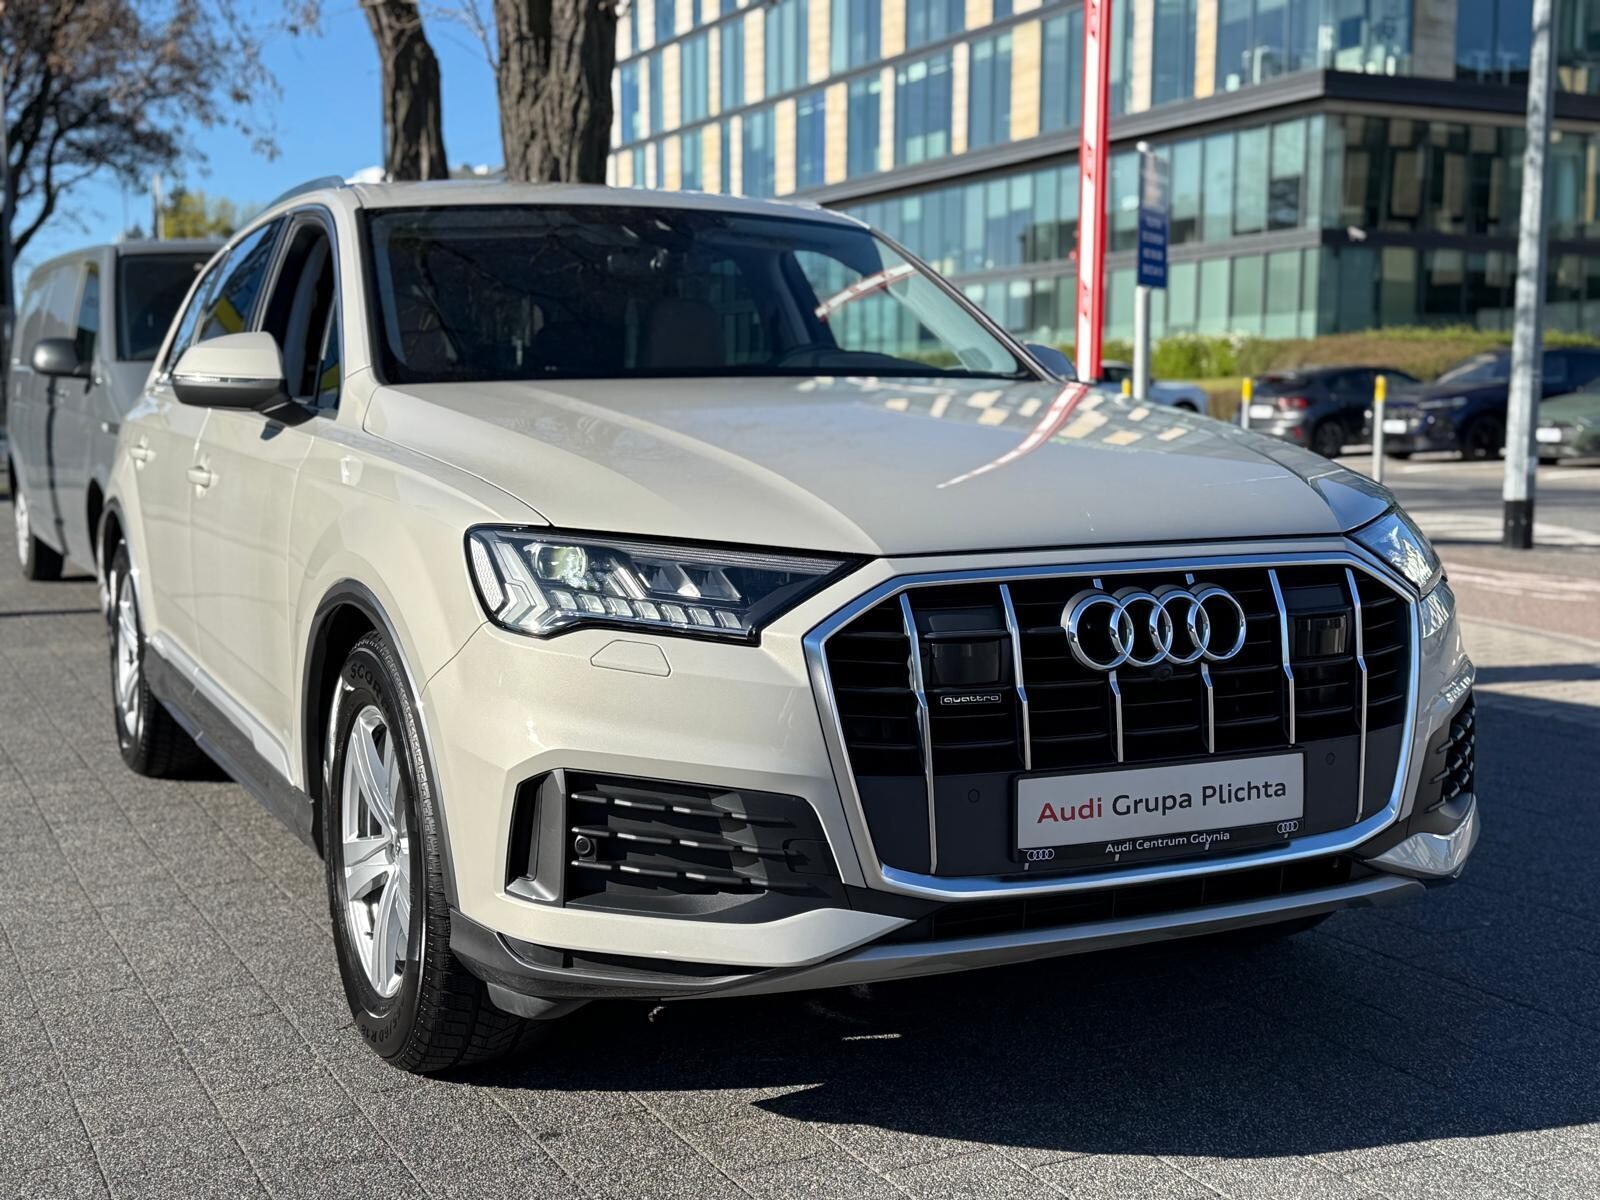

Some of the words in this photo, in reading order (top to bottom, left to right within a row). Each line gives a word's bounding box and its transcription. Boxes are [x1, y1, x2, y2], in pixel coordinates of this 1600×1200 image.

[943, 694, 1000, 705] quattro
[1037, 797, 1103, 824] Audi
[1112, 791, 1192, 816] Grupa
[1202, 780, 1287, 806] Plichta
[1105, 840, 1133, 853] Audi
[1136, 836, 1187, 850] Centrum
[1190, 831, 1230, 846] Gdynia
